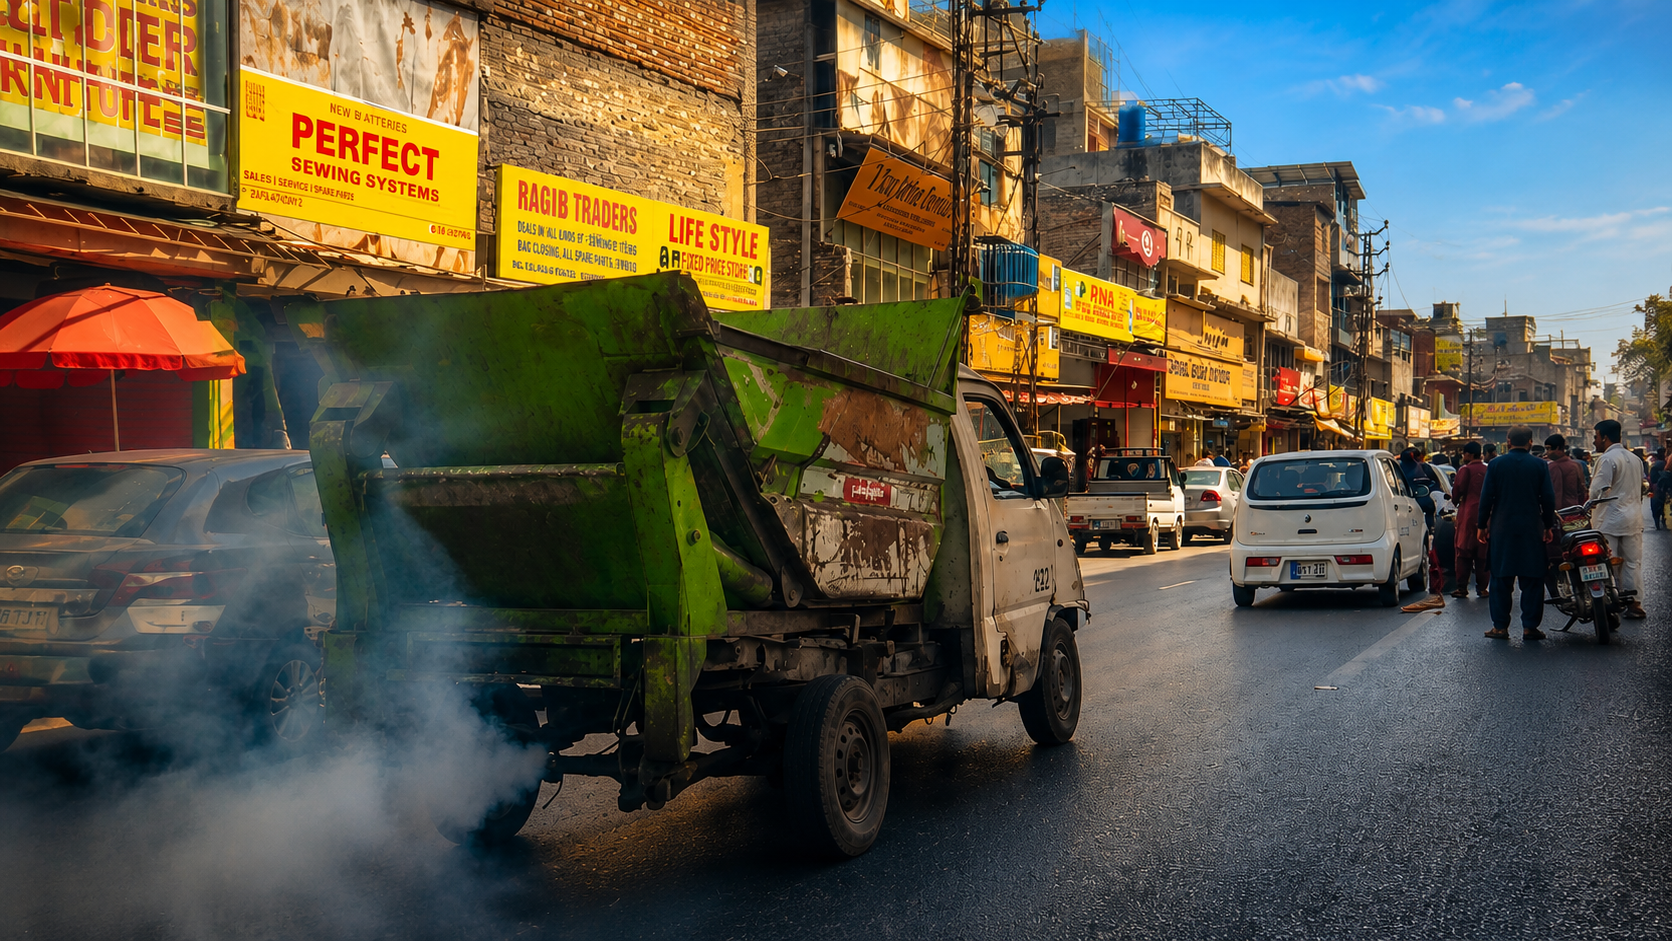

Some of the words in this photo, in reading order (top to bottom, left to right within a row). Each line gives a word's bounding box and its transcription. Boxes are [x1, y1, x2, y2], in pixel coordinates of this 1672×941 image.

[330, 102, 351, 118] NEW
[292, 112, 440, 181] PERFECT
[243, 169, 272, 184] SALES
[291, 157, 361, 186] SEWING
[365, 173, 440, 203] SYSTEMS
[517, 220, 537, 236] DEALS
[518, 179, 569, 220] RAGIB
[573, 192, 638, 235] TRADERS
[669, 213, 705, 249] LIFE
[709, 223, 759, 260] STYLE
